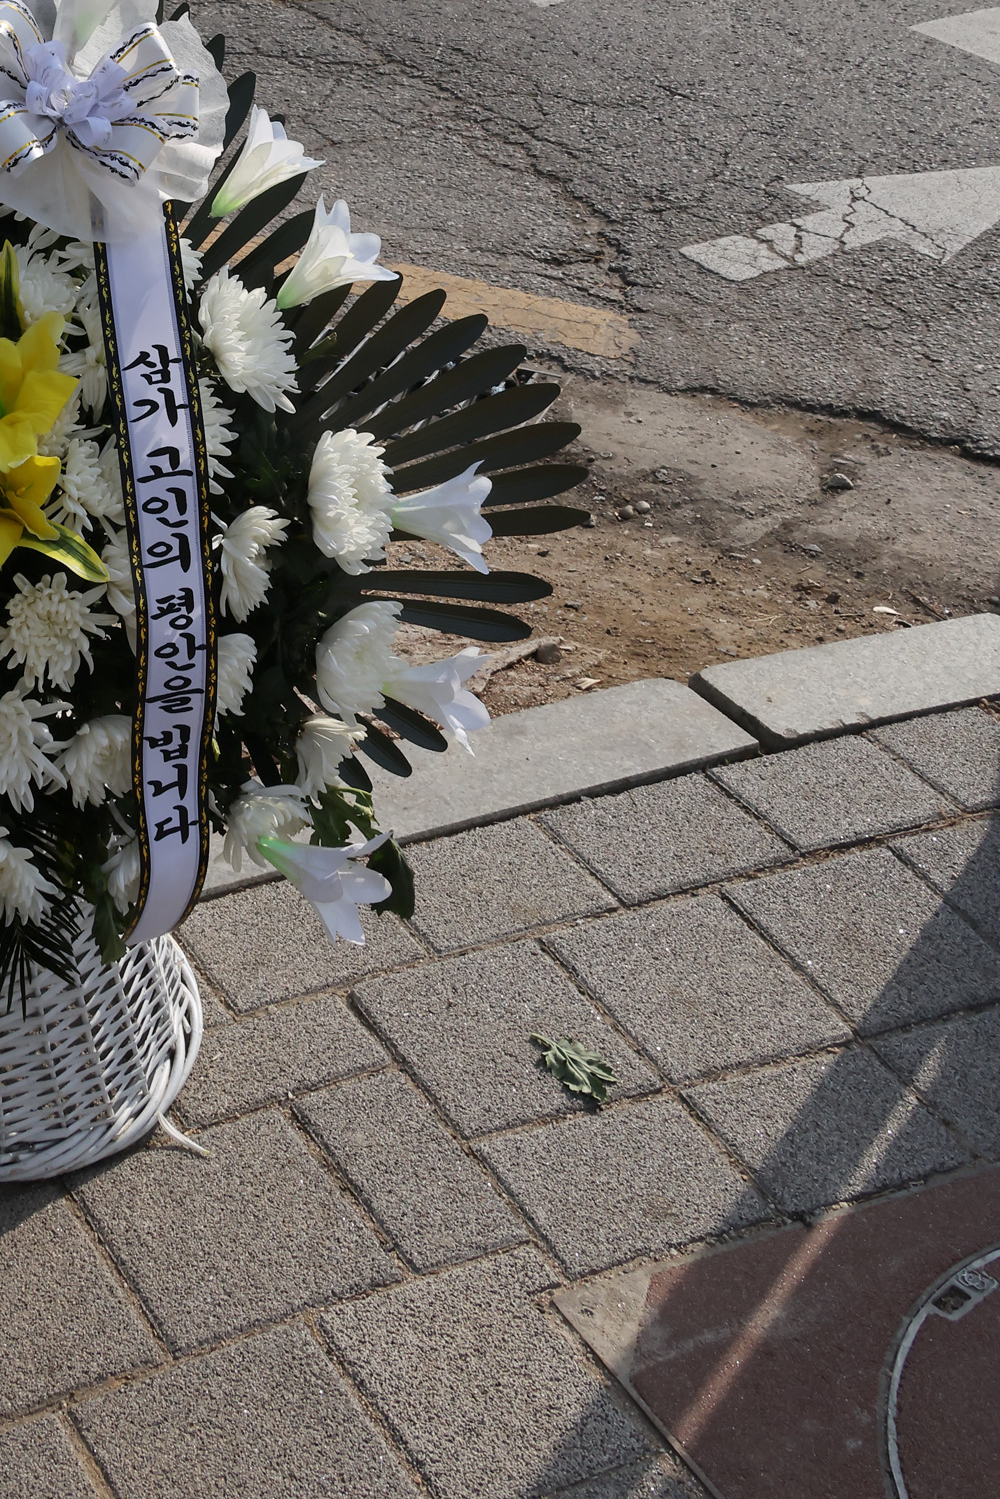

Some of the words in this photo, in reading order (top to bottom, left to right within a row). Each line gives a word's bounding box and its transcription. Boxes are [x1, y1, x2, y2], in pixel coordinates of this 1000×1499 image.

[120, 343, 190, 430] 삼가
[134, 444, 195, 572] 고인의
[144, 588, 206, 713] 평안을
[142, 722, 203, 846] 빕니다
